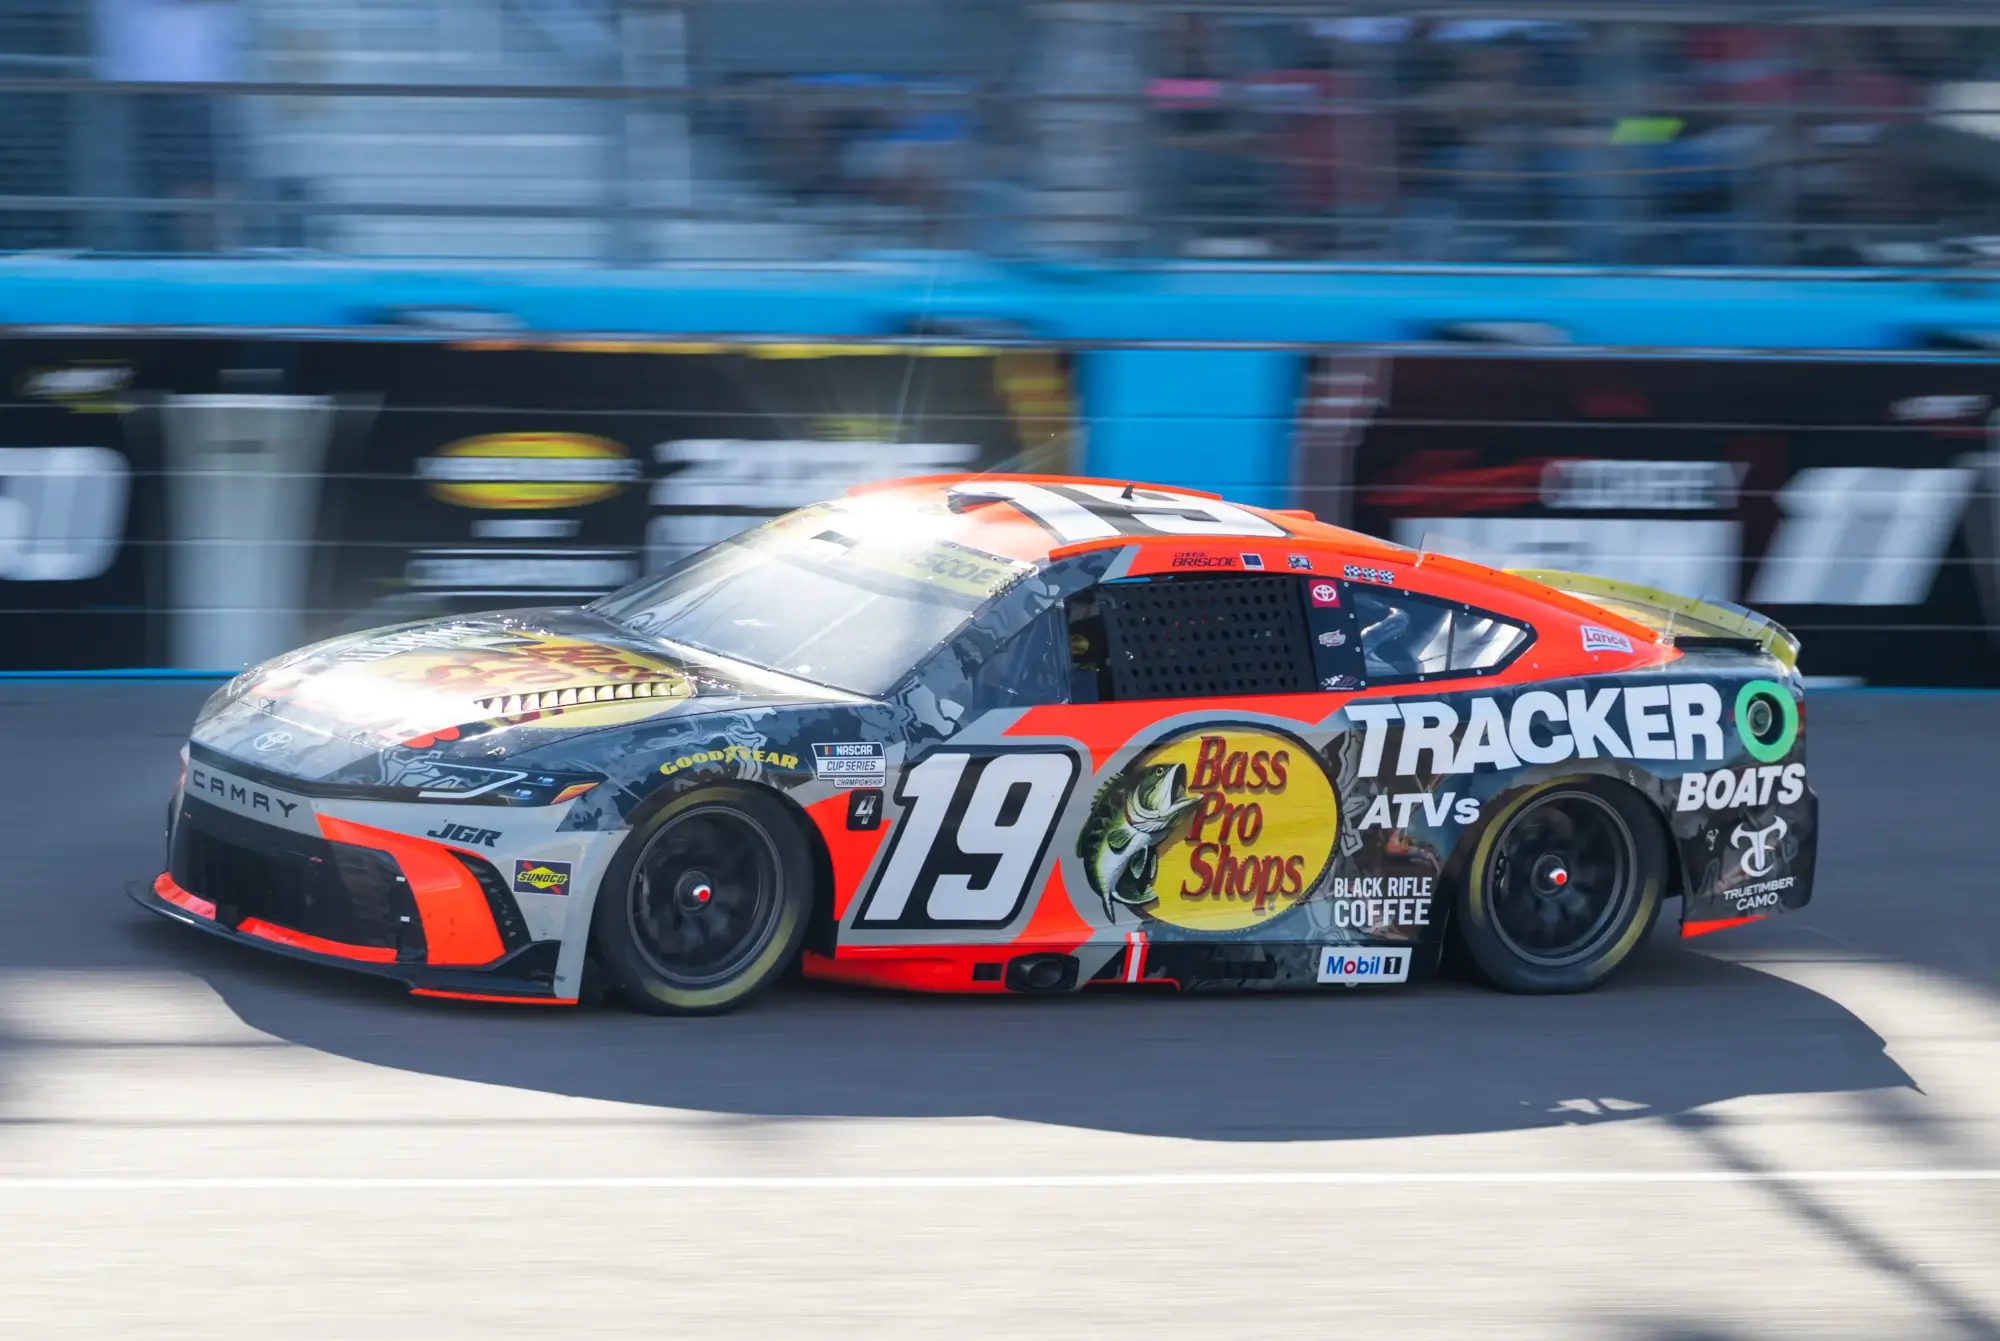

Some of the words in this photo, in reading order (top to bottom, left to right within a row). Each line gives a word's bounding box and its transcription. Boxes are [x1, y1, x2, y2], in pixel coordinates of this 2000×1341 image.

[1172, 557, 1238, 566] BRISCOE
[1584, 628, 1628, 647] Lance
[1344, 683, 1724, 777] TRACKER
[659, 745, 799, 775] GOODYEAR
[836, 745, 873, 756] NASCAR
[1188, 736, 1290, 791] Bass
[827, 760, 844, 771] CUP
[845, 760, 876, 770] SERIES
[193, 769, 298, 818] CAMRY
[1676, 763, 1806, 812] BOATS
[855, 796, 877, 824] 4
[1184, 791, 1263, 844] Pro
[1358, 792, 1481, 830] ATVs
[426, 823, 503, 847] JGR
[864, 753, 1073, 921] 19
[519, 872, 566, 884] SUNOCO
[1180, 842, 1305, 913] Shops
[1334, 877, 1383, 898] BLACK
[1387, 877, 1433, 897] RIFLE
[1723, 876, 1795, 901] TRUETIMBER
[1334, 898, 1432, 928] COFFEE
[1736, 892, 1778, 911] CAMO
[1326, 956, 1380, 974] Mobil
